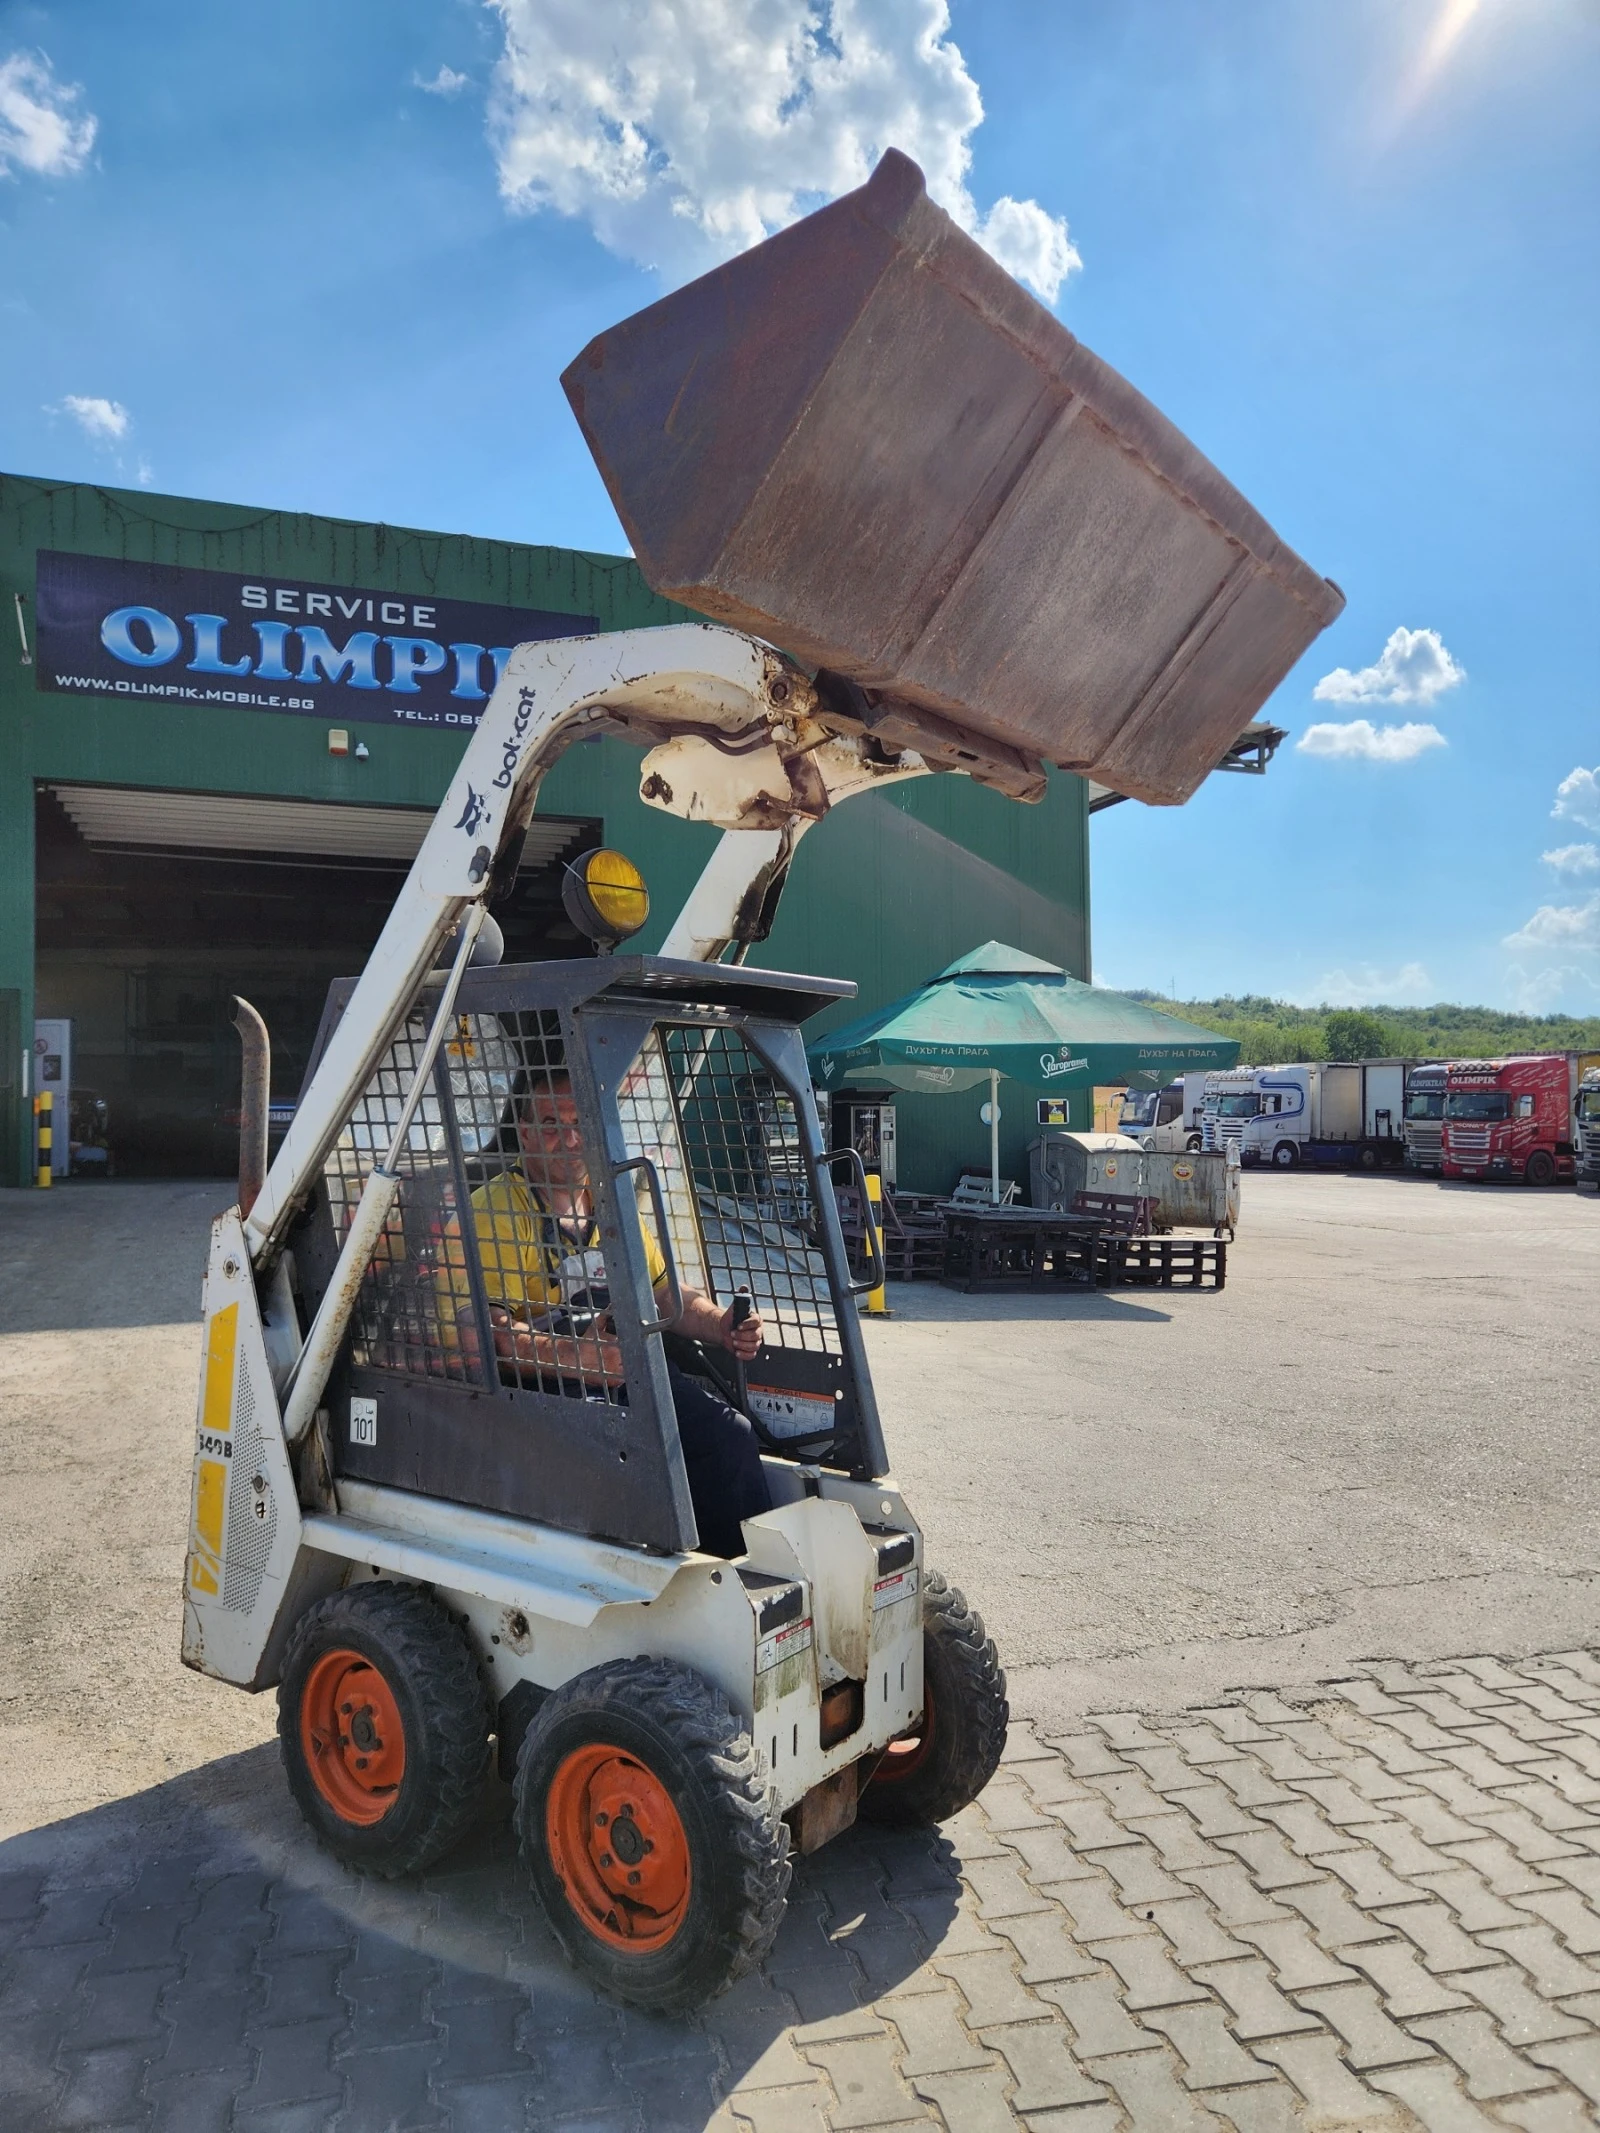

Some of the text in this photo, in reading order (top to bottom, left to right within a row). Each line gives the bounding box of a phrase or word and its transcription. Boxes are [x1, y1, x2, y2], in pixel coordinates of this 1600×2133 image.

[240, 585, 437, 629] SERVICE
[55, 675, 315, 710] WWW.OLIMPIK.MOBILE.BG
[393, 709, 440, 721] TEL.:
[1040, 1053, 1090, 1079] Staropramen
[1451, 1076, 1497, 1085] OLIMPIK
[353, 1417, 373, 1442] 101
